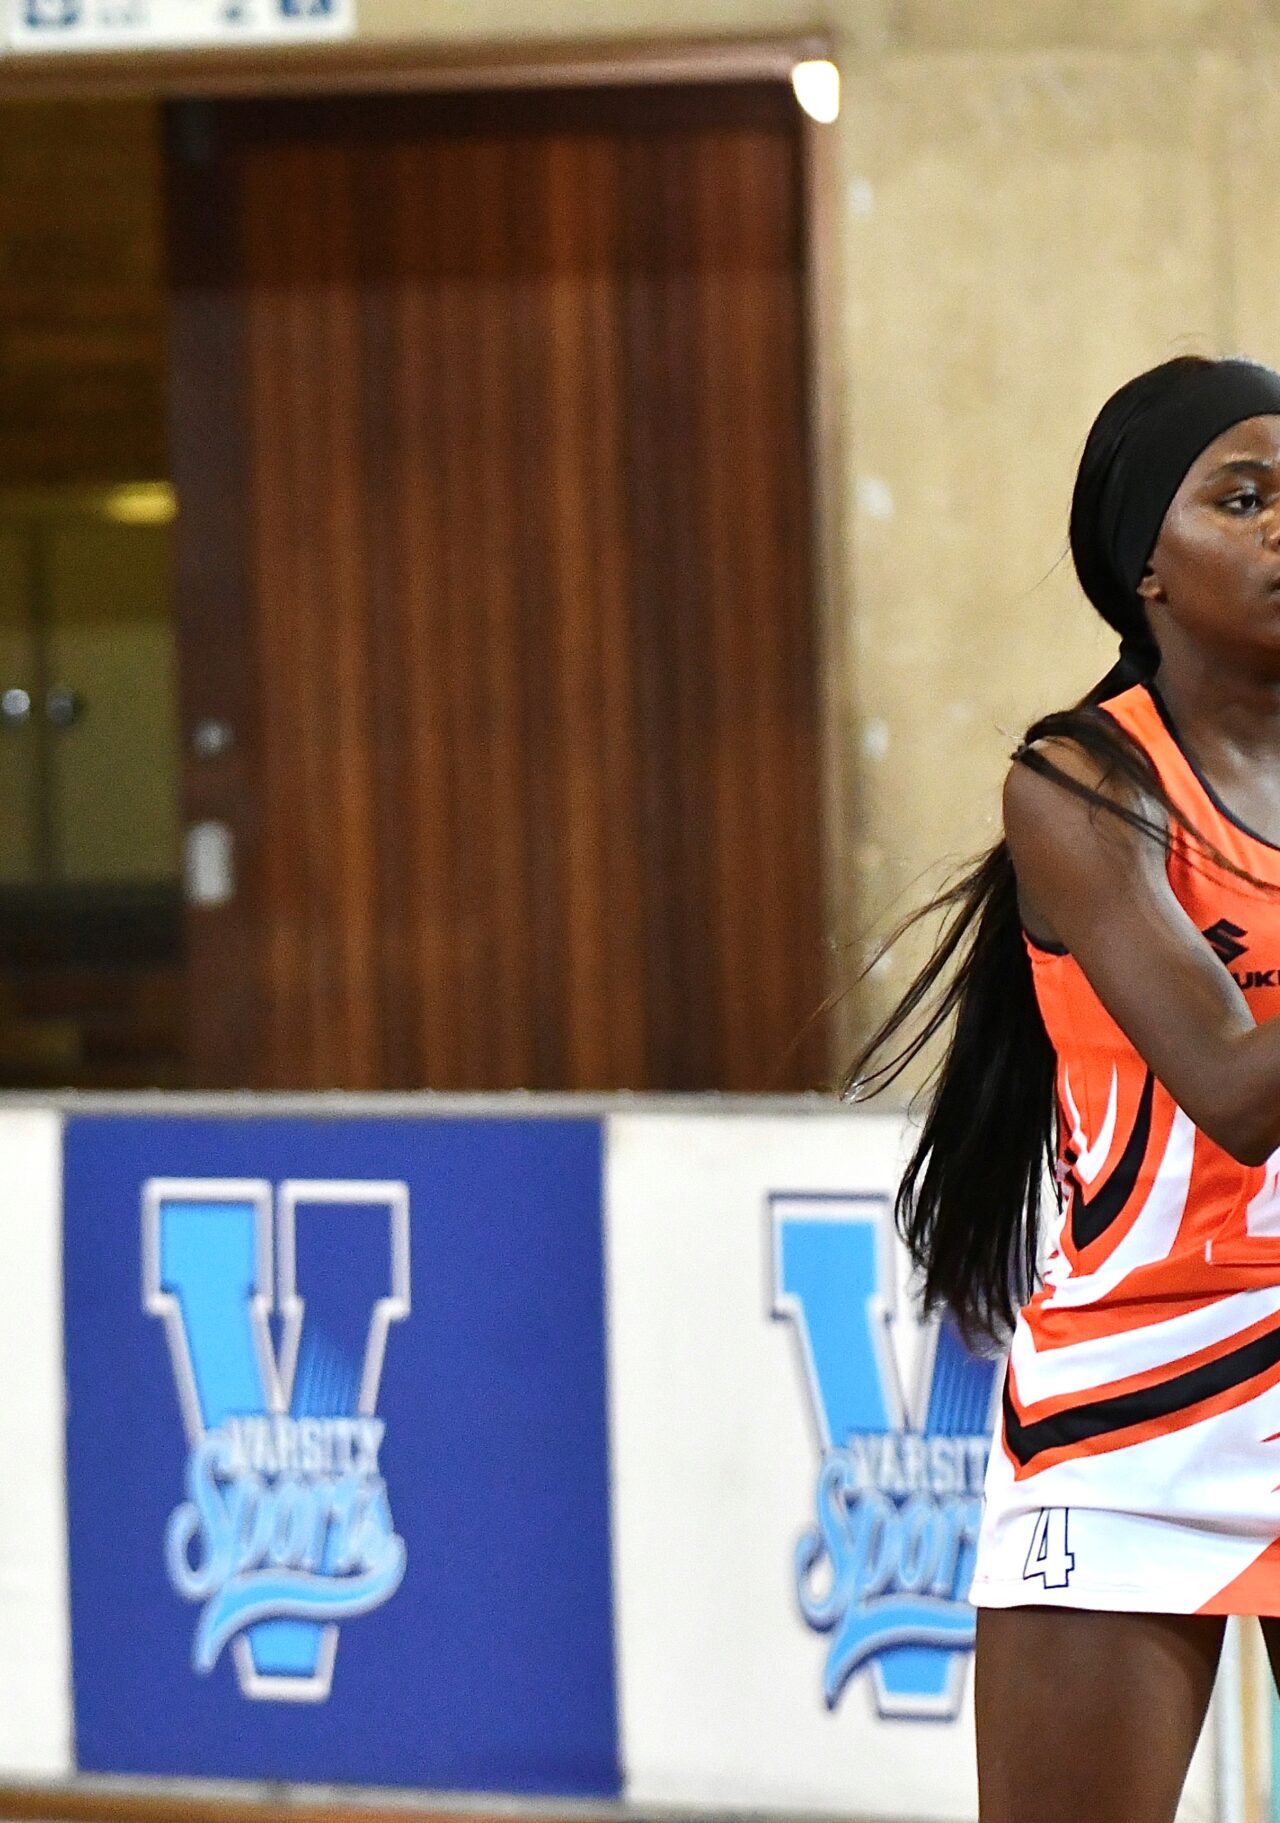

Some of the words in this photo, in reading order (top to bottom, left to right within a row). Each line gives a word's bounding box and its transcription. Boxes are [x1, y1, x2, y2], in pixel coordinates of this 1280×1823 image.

[224, 1415, 385, 1474] VARSITY
[846, 1433, 993, 1494] VARSIT
[165, 1437, 408, 1600] Sports
[796, 1447, 984, 1633] Spor
[1022, 1506, 1076, 1590] 4
